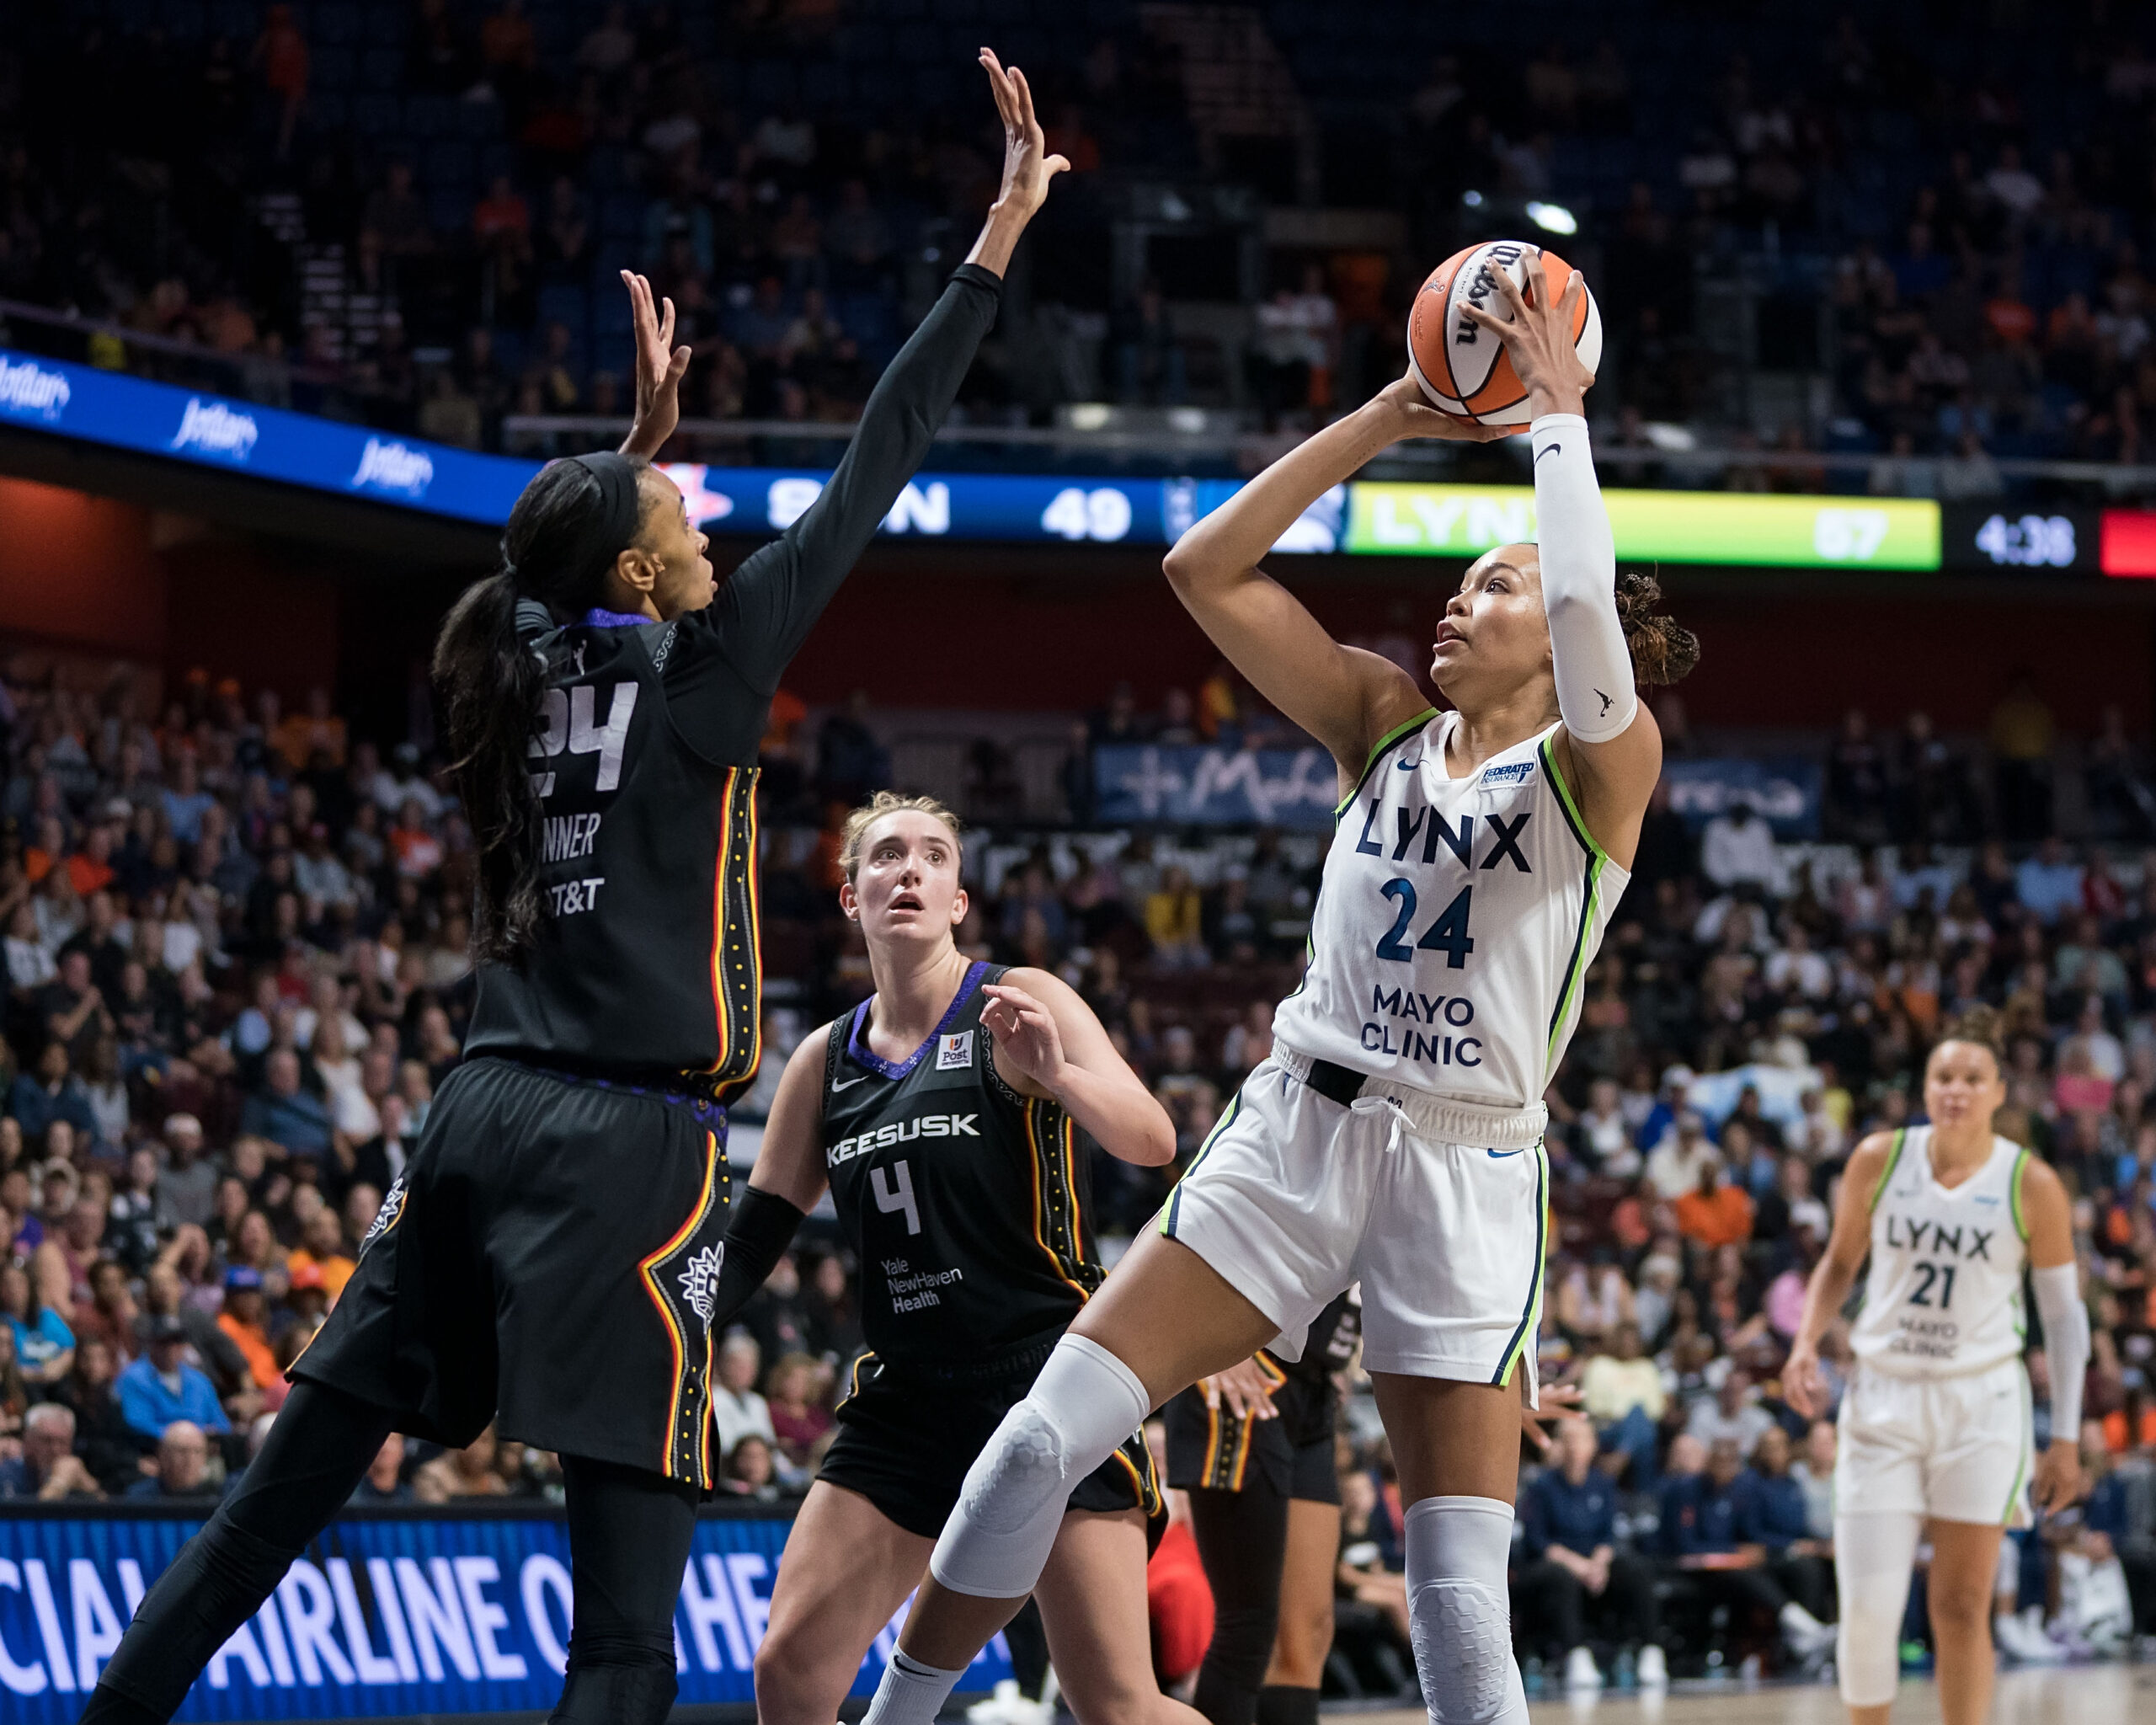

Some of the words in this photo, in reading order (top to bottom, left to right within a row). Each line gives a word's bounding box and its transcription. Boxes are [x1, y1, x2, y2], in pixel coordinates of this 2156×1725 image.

[767, 478, 950, 534] SN
[1374, 494, 1537, 546] LYN
[1483, 762, 1534, 778] FEDERATED
[542, 812, 601, 863] NNER
[1356, 798, 1531, 873] LYNX
[1376, 878, 1474, 969] 24
[1373, 985, 1474, 1027] MAYO
[942, 1048, 968, 1061] Post
[1361, 1022, 1482, 1066] CLINIC
[826, 1114, 981, 1169] KEESUSK
[870, 1160, 921, 1235] 4
[1886, 1216, 1993, 1260] LYNX
[881, 1258, 910, 1276] Yale
[1908, 1261, 1956, 1309] 21
[893, 1290, 941, 1315] Health
[674, 1552, 771, 1674] HE
